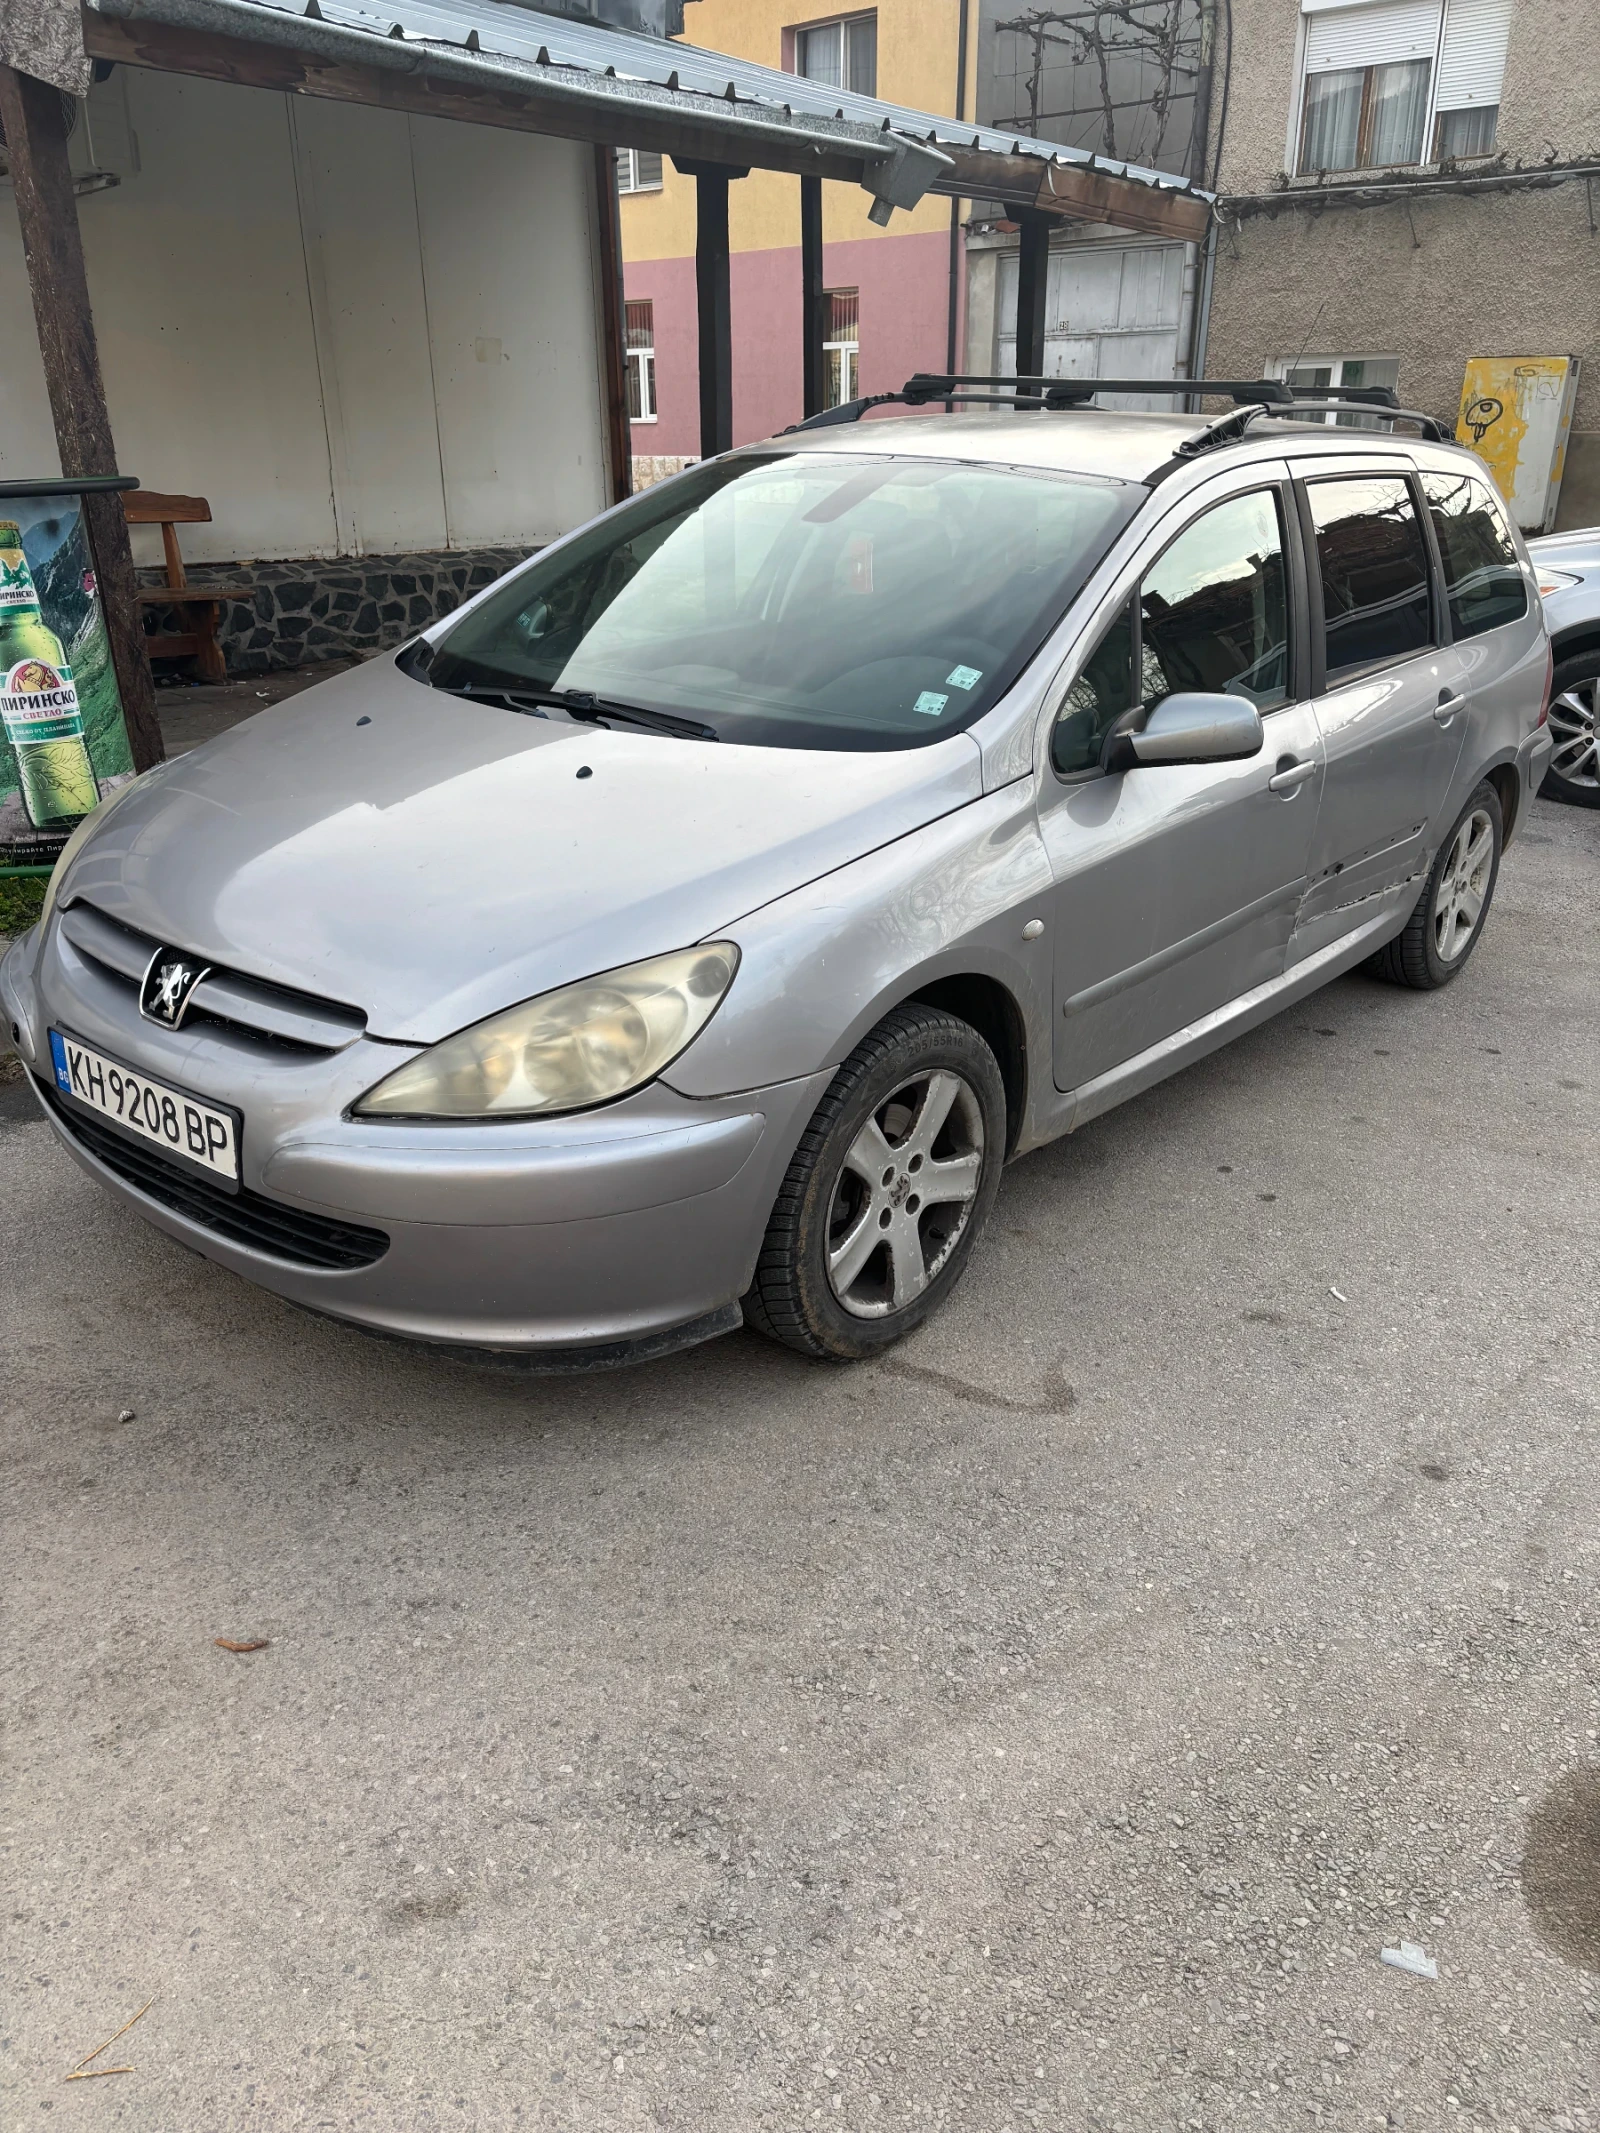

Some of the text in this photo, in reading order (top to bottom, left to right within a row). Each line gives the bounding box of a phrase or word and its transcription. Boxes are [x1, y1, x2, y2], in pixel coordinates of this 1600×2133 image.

[0, 590, 34, 600] ИРИНСКО
[1, 689, 76, 711] ПИРИНСКО
[23, 708, 62, 719] СВЕТЛО
[47, 844, 65, 852] Пир
[907, 1034, 963, 1057] 205/55R16
[58, 1067, 69, 1084] BG
[68, 1046, 227, 1162] KH9208BP
